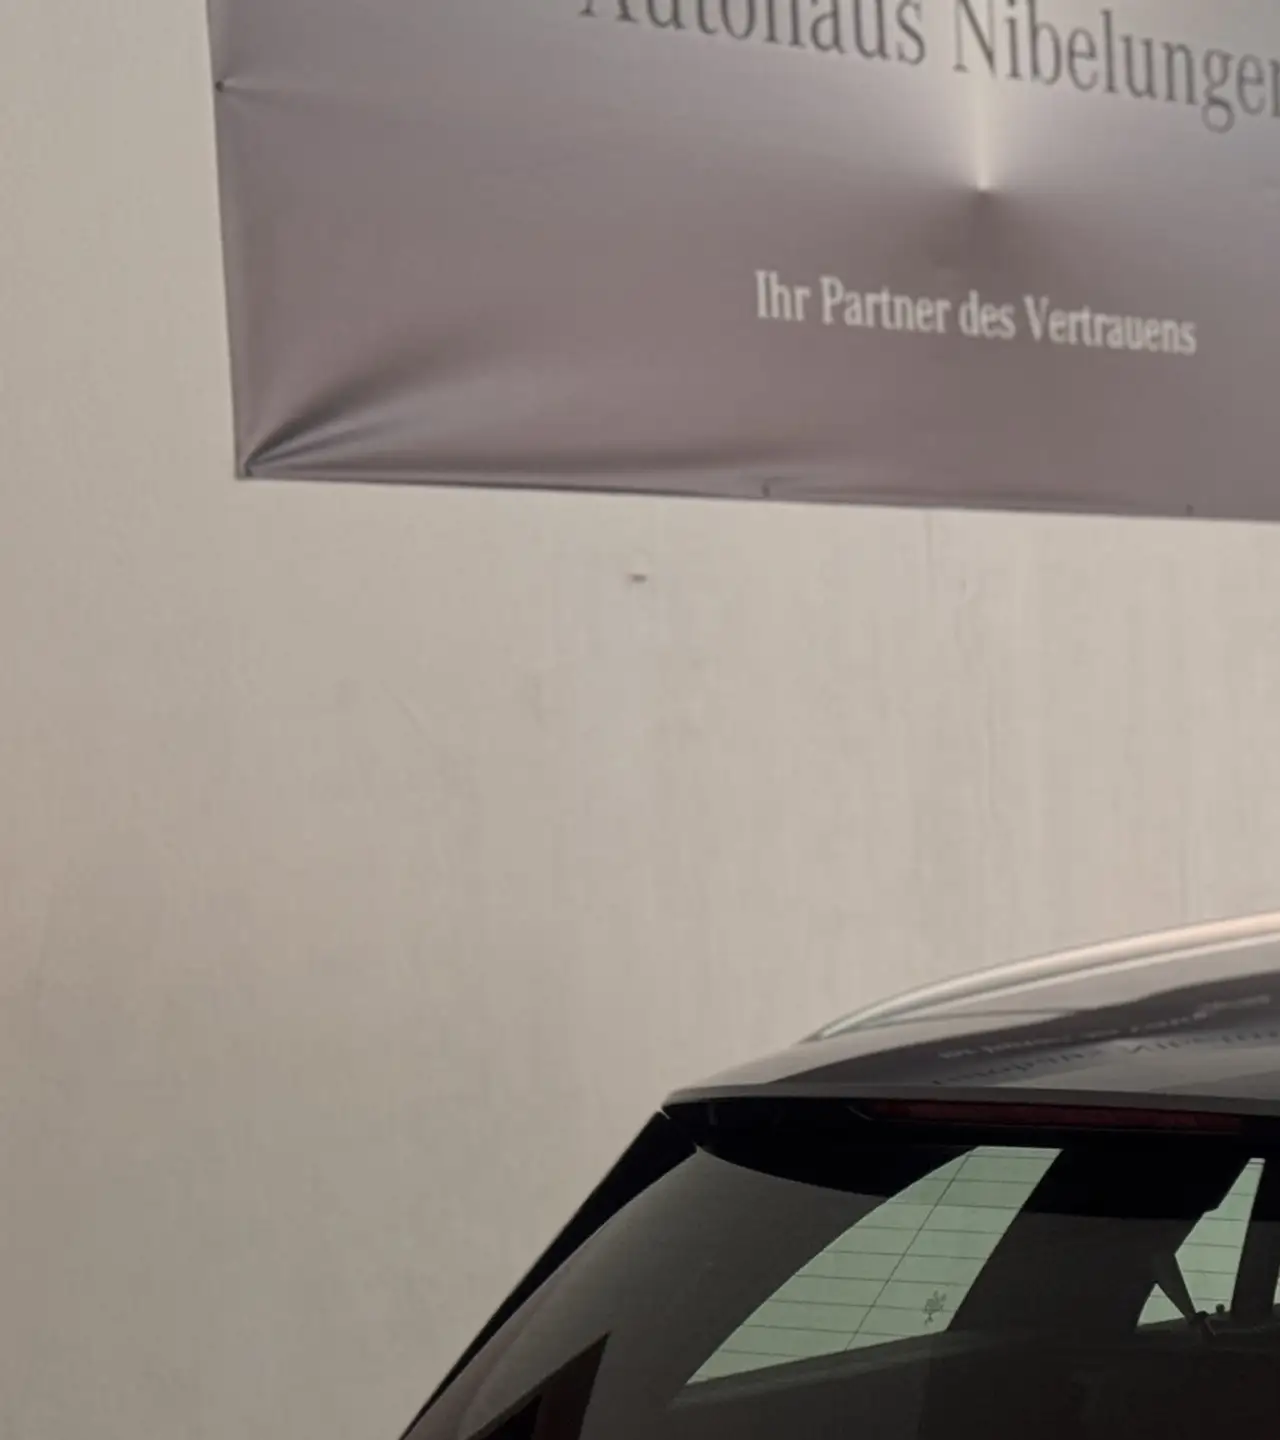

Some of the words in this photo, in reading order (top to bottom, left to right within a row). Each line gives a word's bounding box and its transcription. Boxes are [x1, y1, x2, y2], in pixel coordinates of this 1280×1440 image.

[579, 0, 926, 66] utohaus
[755, 269, 811, 322] Ihr
[819, 275, 951, 335] Partner
[958, 289, 1016, 341] des
[1023, 295, 1198, 355] Vertrauens
